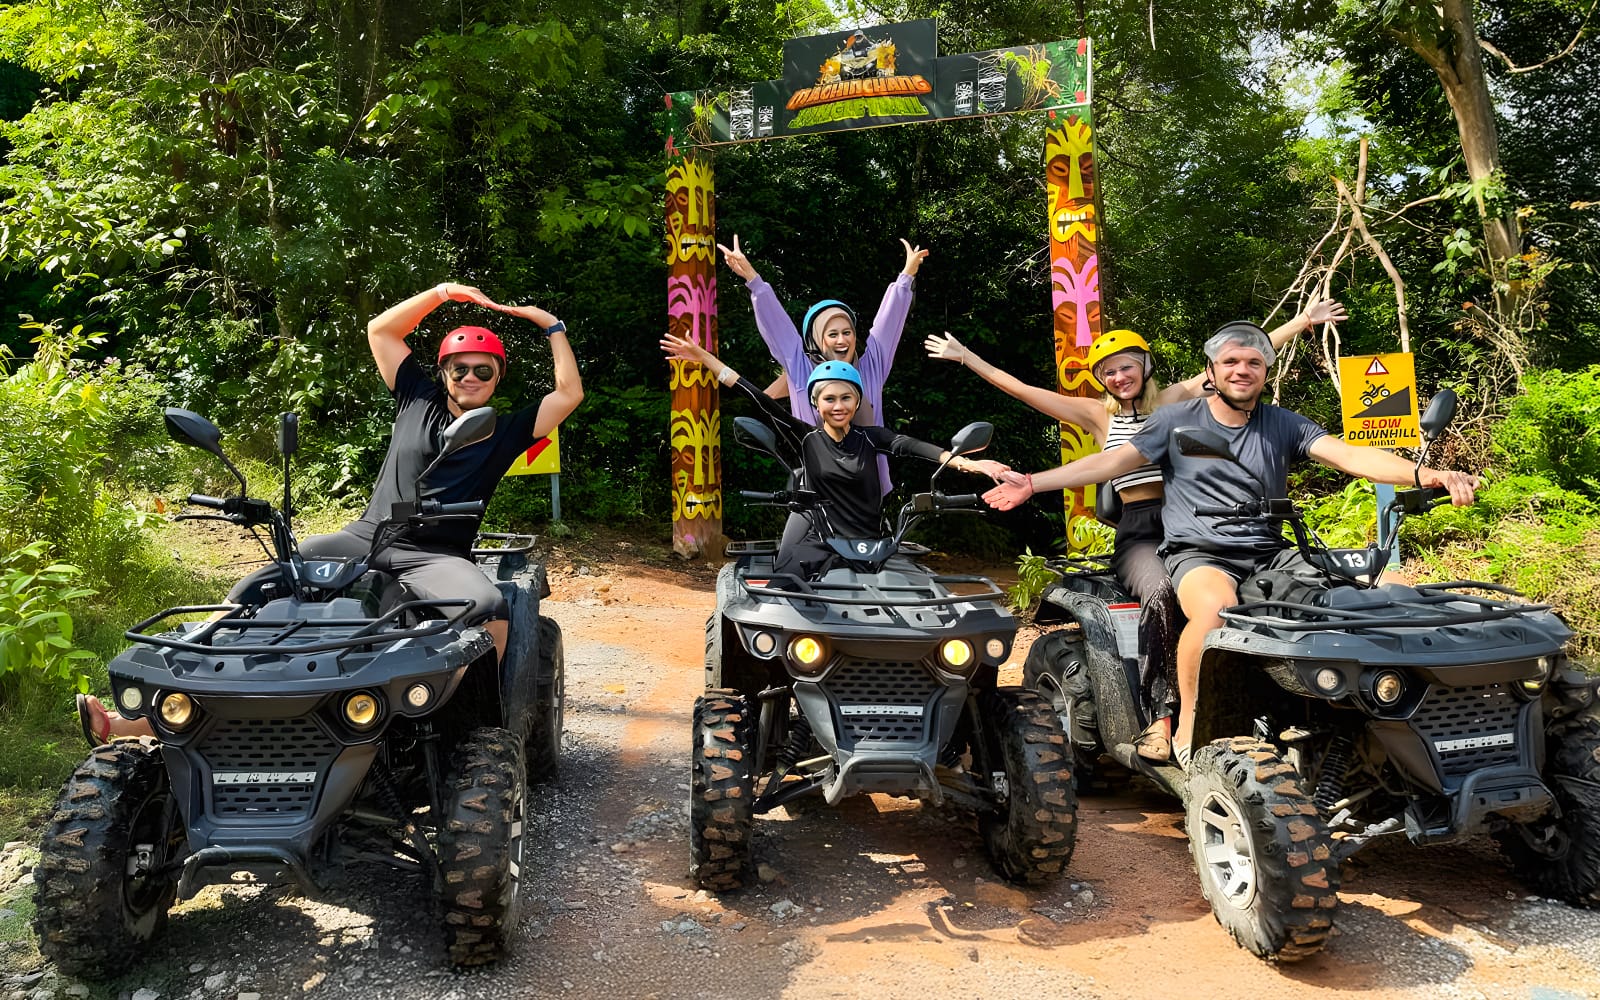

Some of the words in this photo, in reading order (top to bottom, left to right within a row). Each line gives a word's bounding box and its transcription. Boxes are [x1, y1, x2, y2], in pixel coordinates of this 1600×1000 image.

[1362, 418, 1402, 430] SLOW
[1348, 428, 1417, 440] DOWNHILL
[857, 542, 868, 554] 6
[1343, 553, 1366, 568] 13
